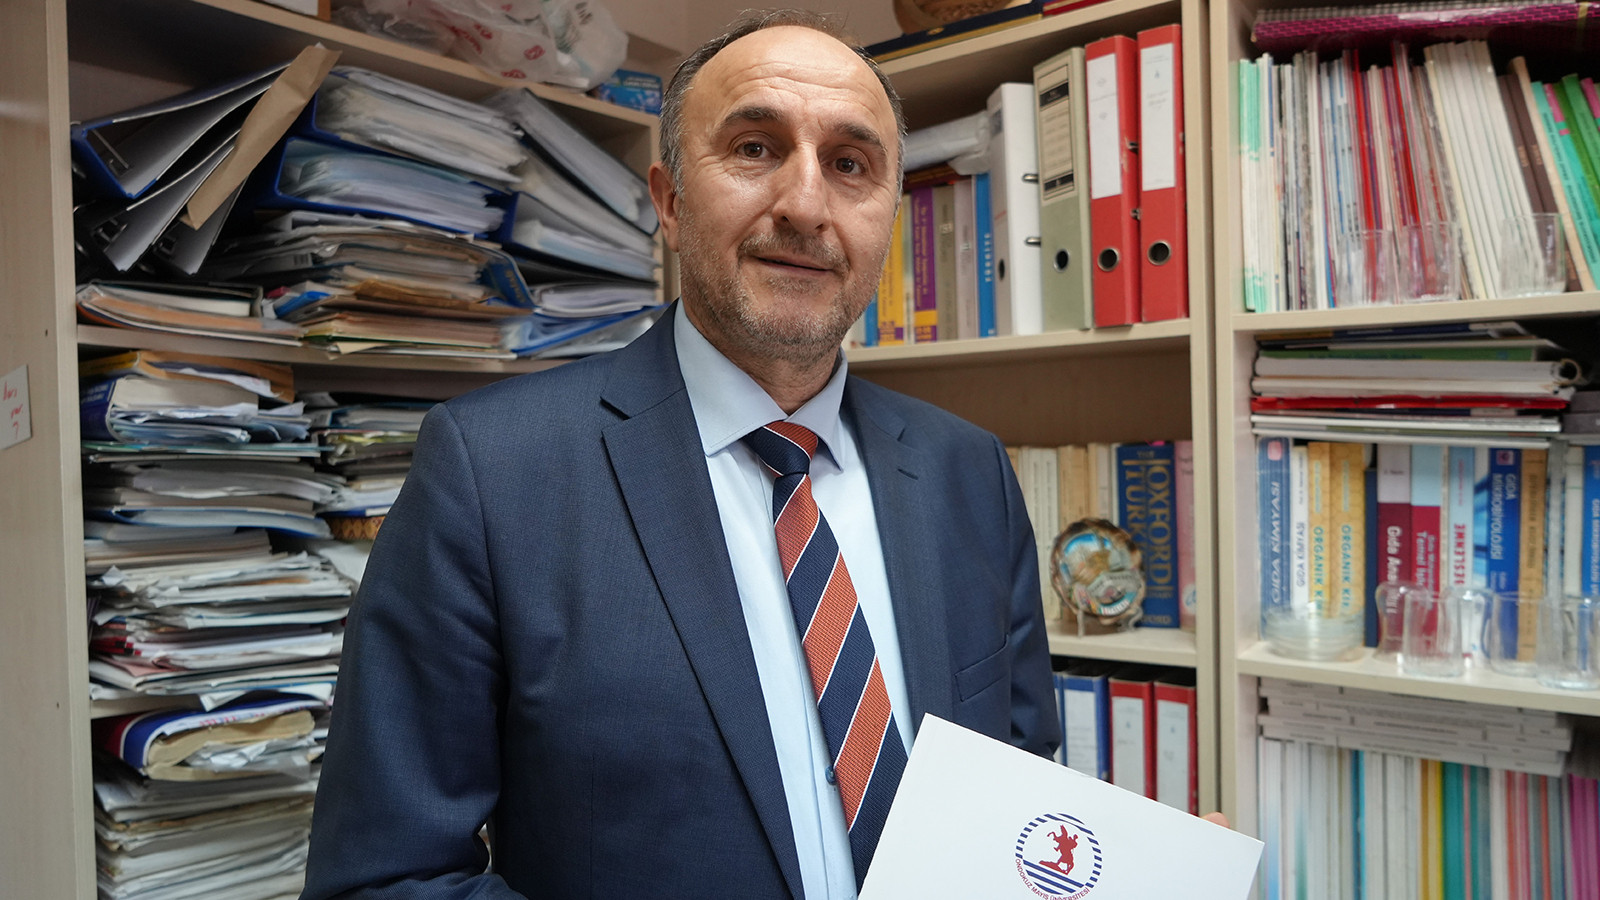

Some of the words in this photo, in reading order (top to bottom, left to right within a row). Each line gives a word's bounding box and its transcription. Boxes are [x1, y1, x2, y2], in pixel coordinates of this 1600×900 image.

[1126, 466, 1148, 558] TURK
[1505, 473, 1516, 500] GIDA
[1149, 466, 1171, 585] OXFORD
[1341, 524, 1352, 583] ORGANİK
[1271, 559, 1281, 604] GIDA
[1313, 526, 1324, 585] ORGANİK
[1015, 858, 1033, 889] ONDOKUZ
[1031, 887, 1050, 900] MAYIS
